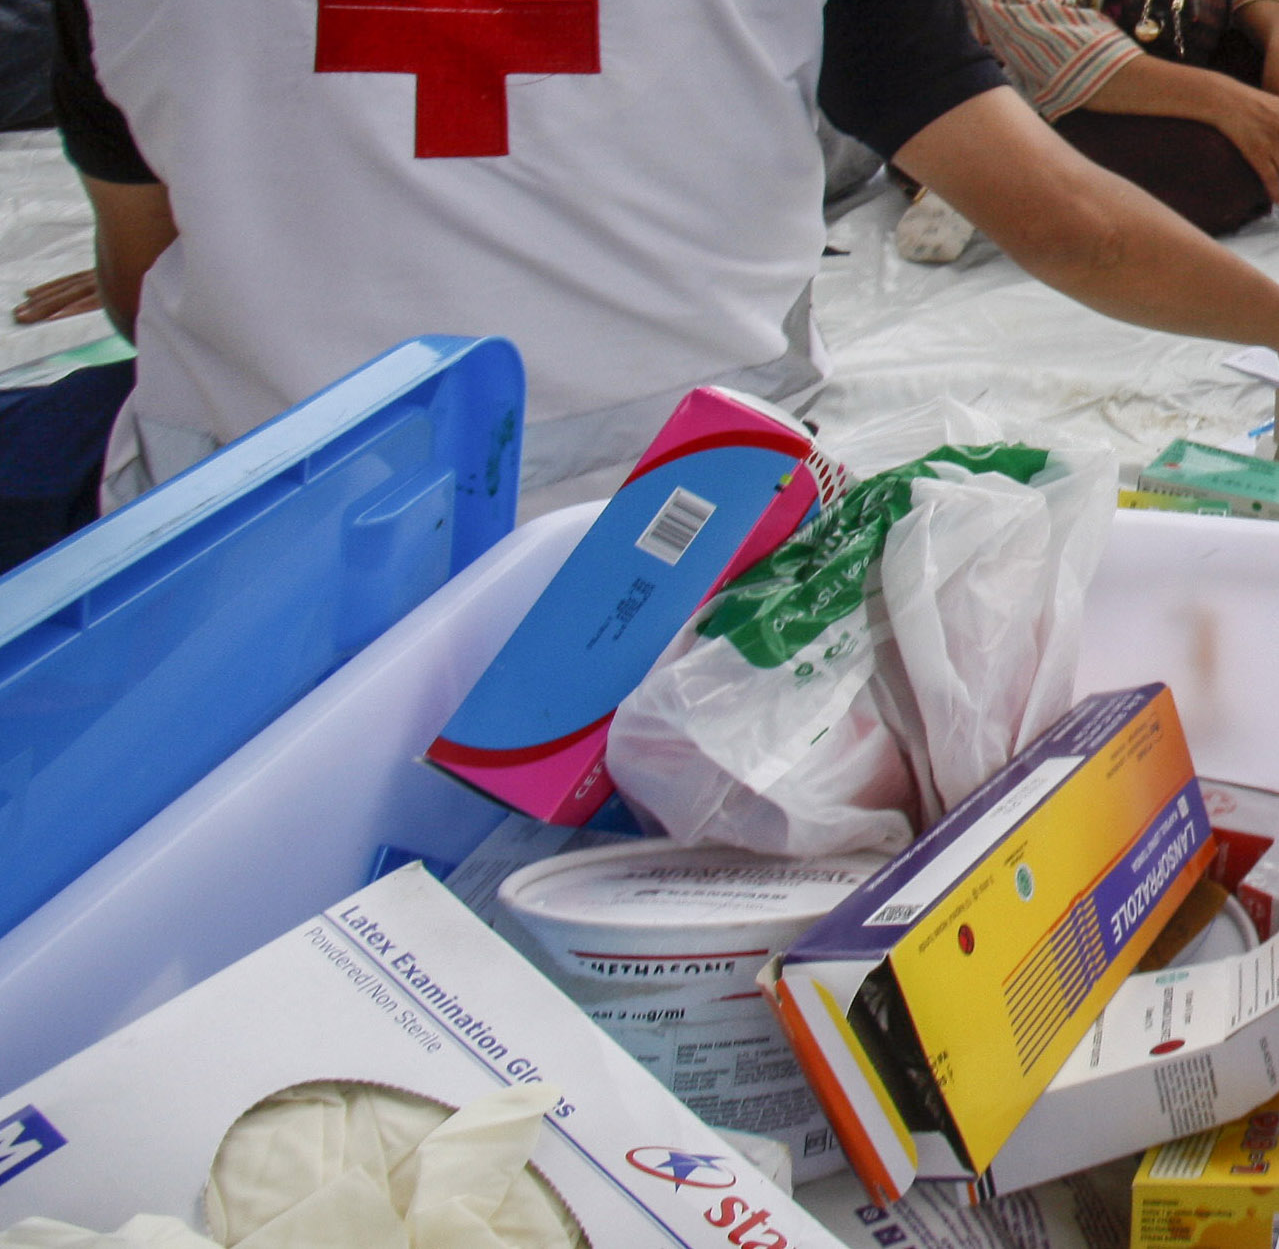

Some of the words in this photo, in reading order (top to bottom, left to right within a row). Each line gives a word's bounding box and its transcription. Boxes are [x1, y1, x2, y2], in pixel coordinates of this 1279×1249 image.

[1111, 820, 1197, 944] LANSOPRAZOLE
[340, 905, 397, 956] Latex
[391, 952, 509, 1060] Examination
[394, 1008, 443, 1054] Sterile
